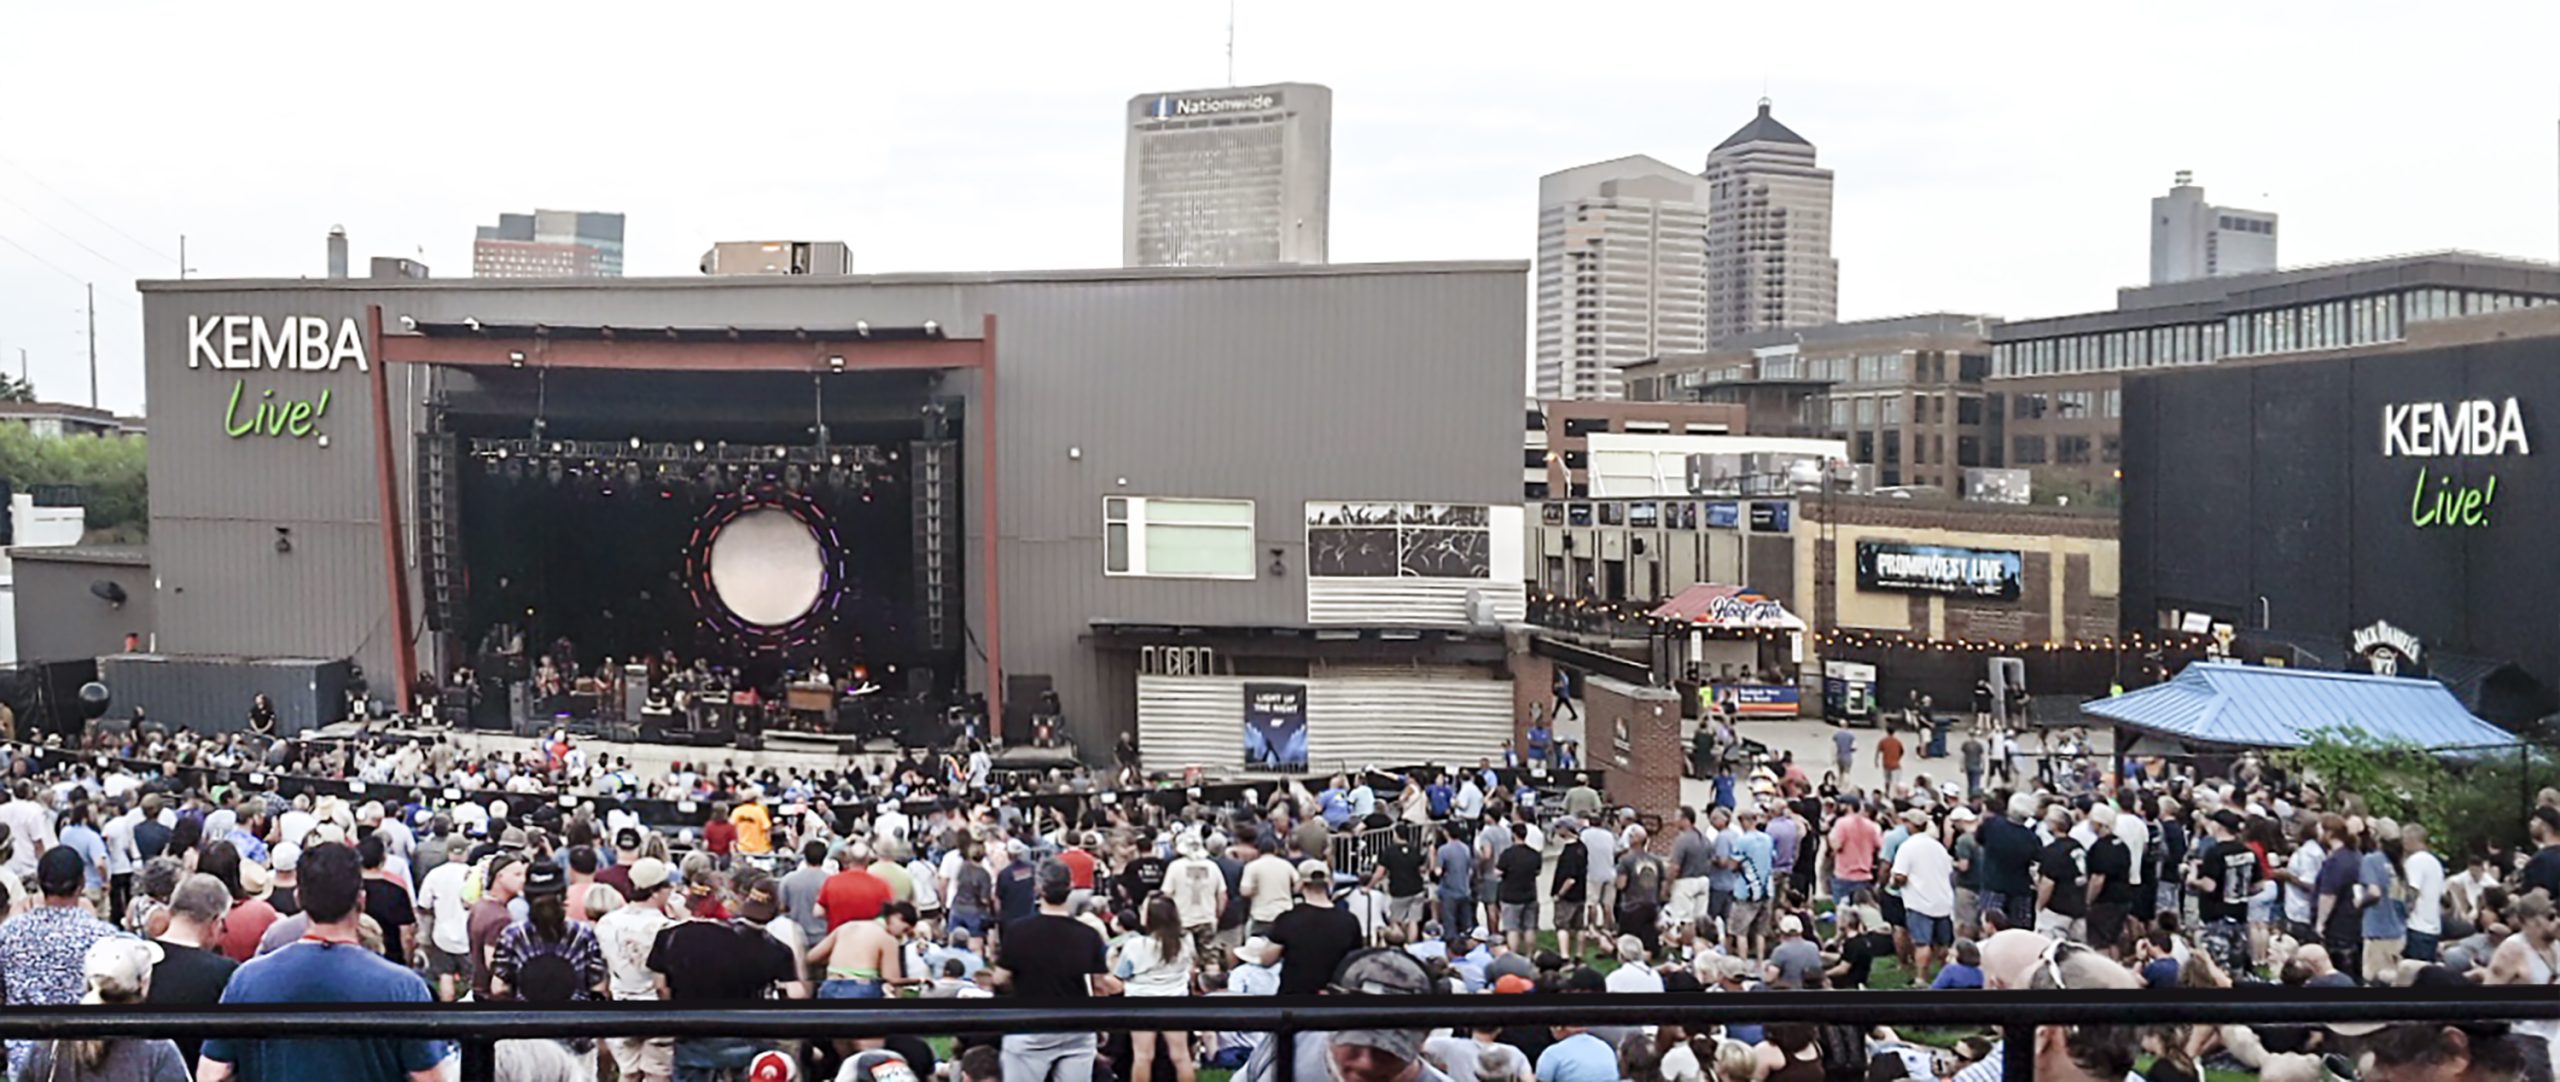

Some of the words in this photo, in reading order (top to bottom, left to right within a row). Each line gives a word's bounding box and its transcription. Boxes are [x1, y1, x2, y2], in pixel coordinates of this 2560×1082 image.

[1177, 95, 1273, 114] Nationwide
[188, 315, 369, 371] KEMBA
[225, 379, 331, 437] Live!
[2384, 397, 2529, 456] KEMBA
[2412, 466, 2496, 527] Live!
